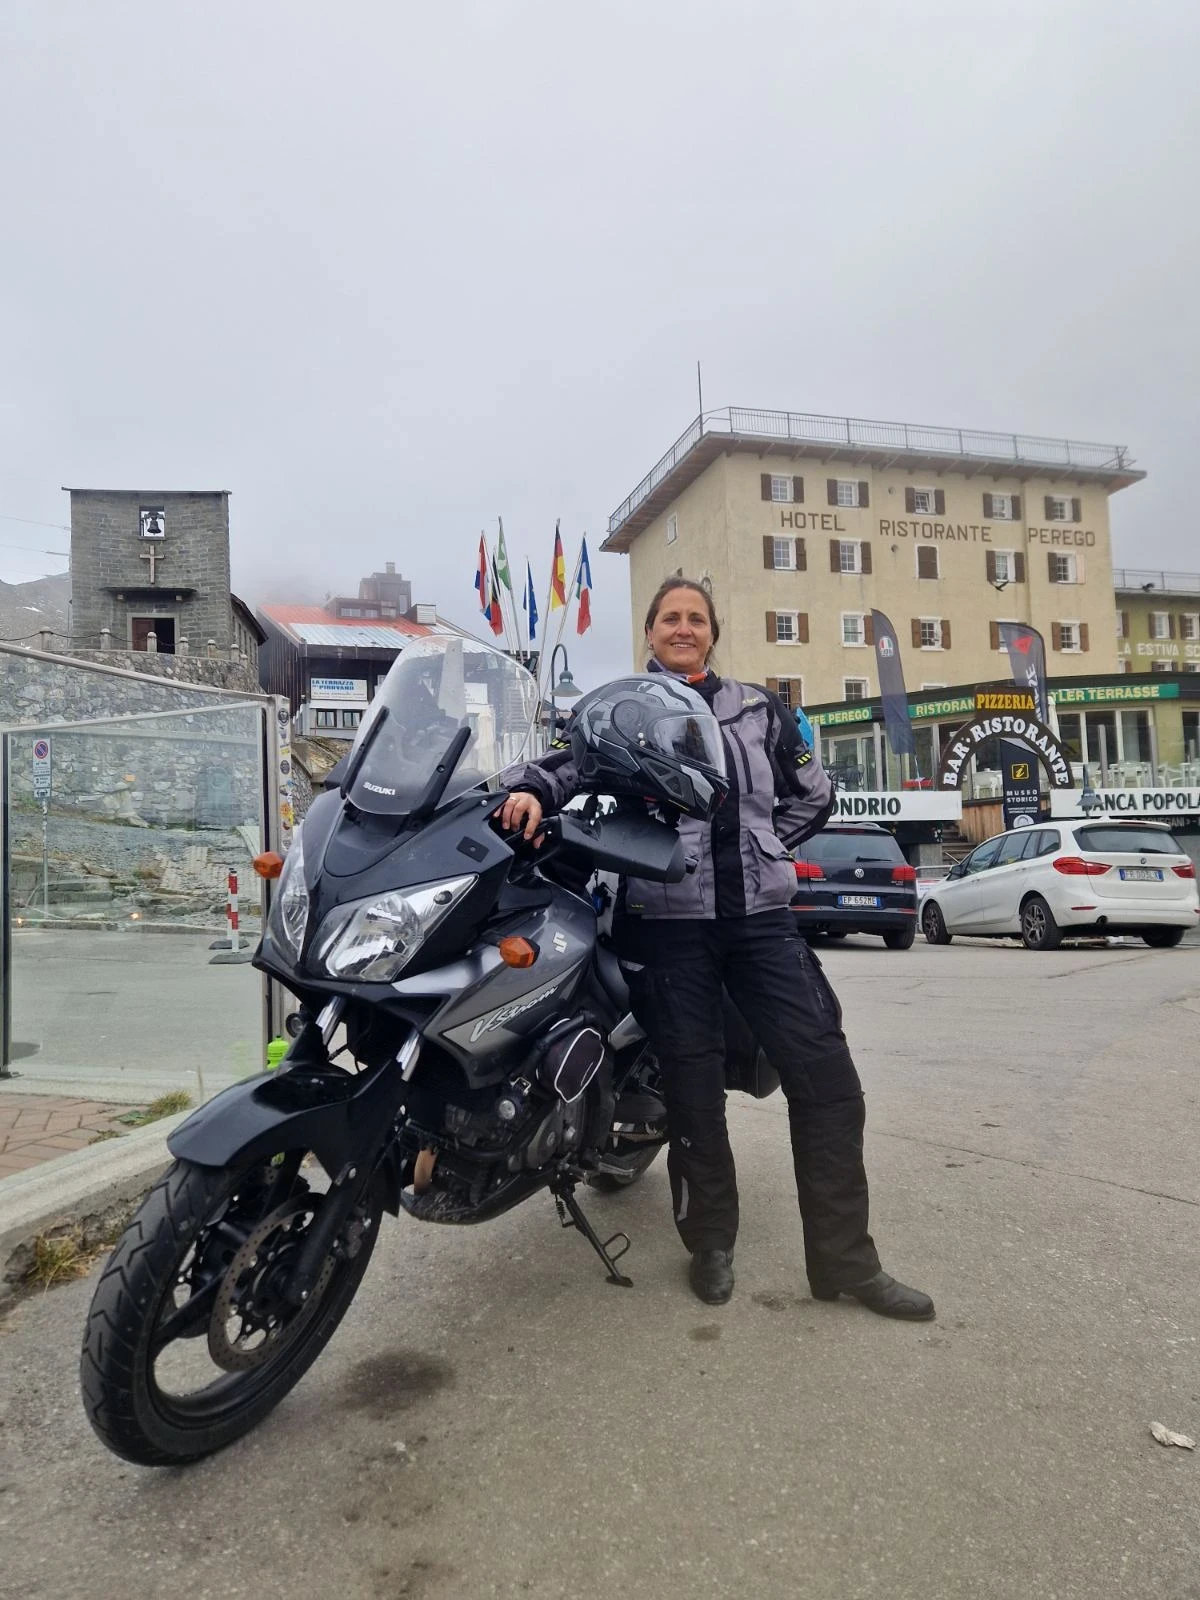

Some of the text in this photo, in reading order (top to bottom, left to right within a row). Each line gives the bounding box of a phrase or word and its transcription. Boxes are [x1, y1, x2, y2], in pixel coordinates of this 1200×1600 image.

[780, 510, 1096, 547] HOTEL RISTORANTE PEREGO
[1136, 642, 1179, 656] ESTIVA
[1088, 685, 1160, 700] TERRASSE
[976, 694, 1035, 710] PIZZERIA
[828, 708, 870, 725] PEREGO
[943, 716, 1069, 787] BAR RISTORANTE
[362, 781, 396, 796] SUZUKI
[1081, 793, 1138, 811] ANCA
